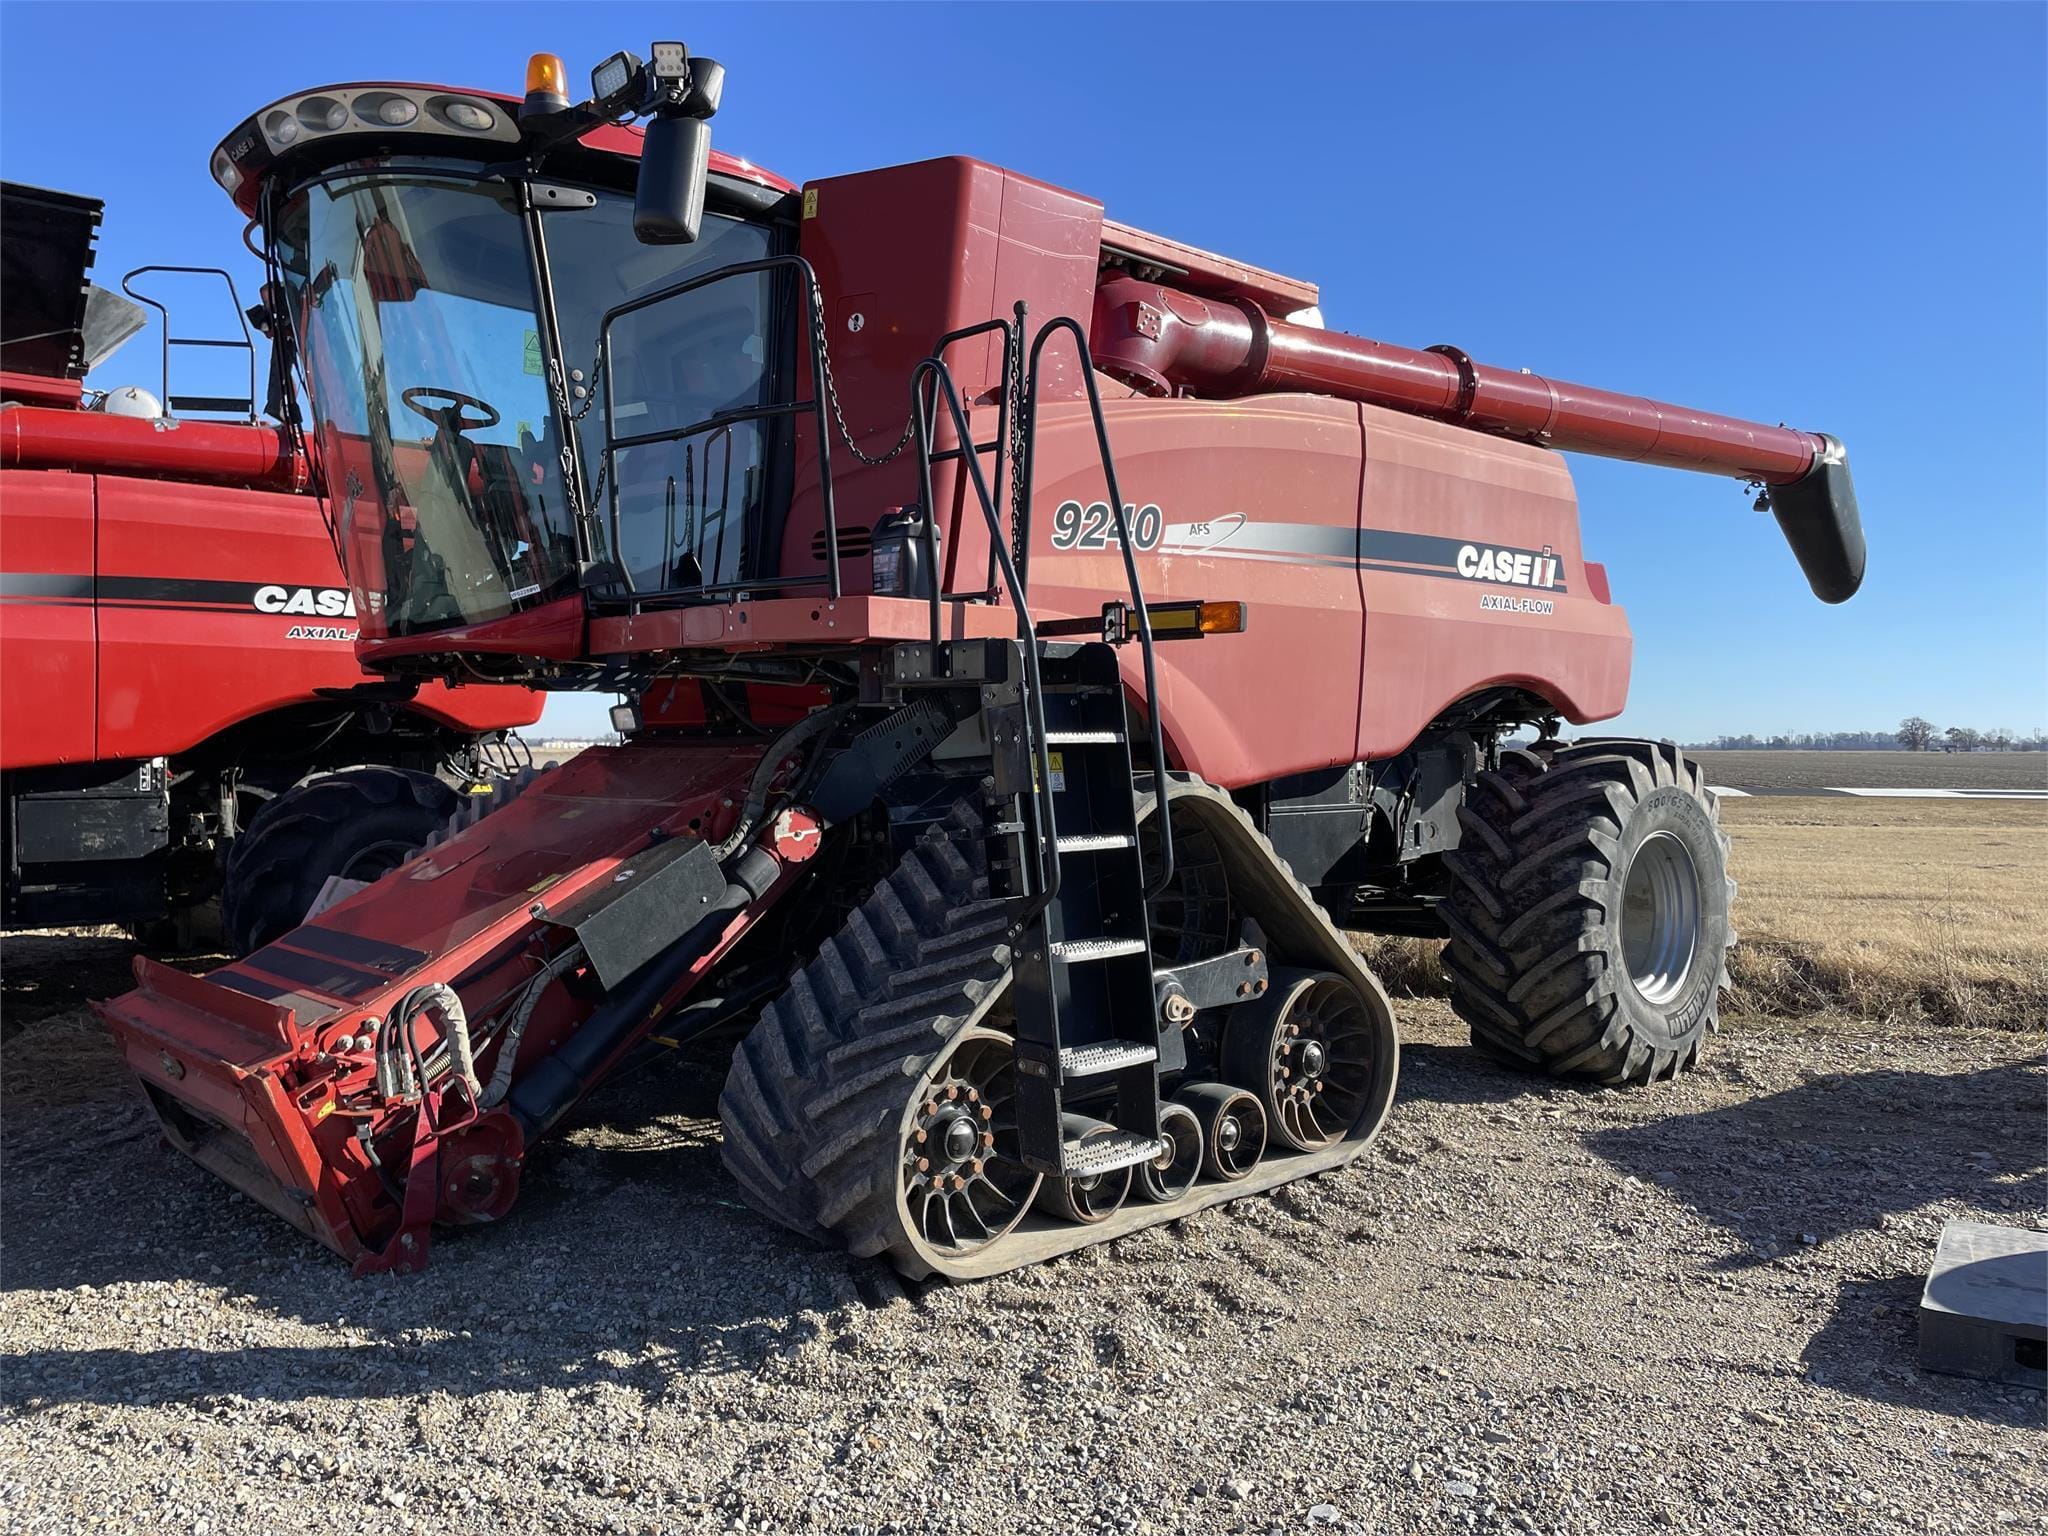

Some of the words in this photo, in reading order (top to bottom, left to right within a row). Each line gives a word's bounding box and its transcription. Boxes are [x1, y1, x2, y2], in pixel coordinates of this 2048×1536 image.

[1051, 500, 1162, 551] 9240
[1189, 523, 1211, 536] AFS
[1457, 545, 1532, 586] CASE
[1480, 594, 1553, 615] AXIAL-FLOW
[285, 625, 360, 641] AXIAL-
[1669, 952, 1717, 1038] MICHELIN
